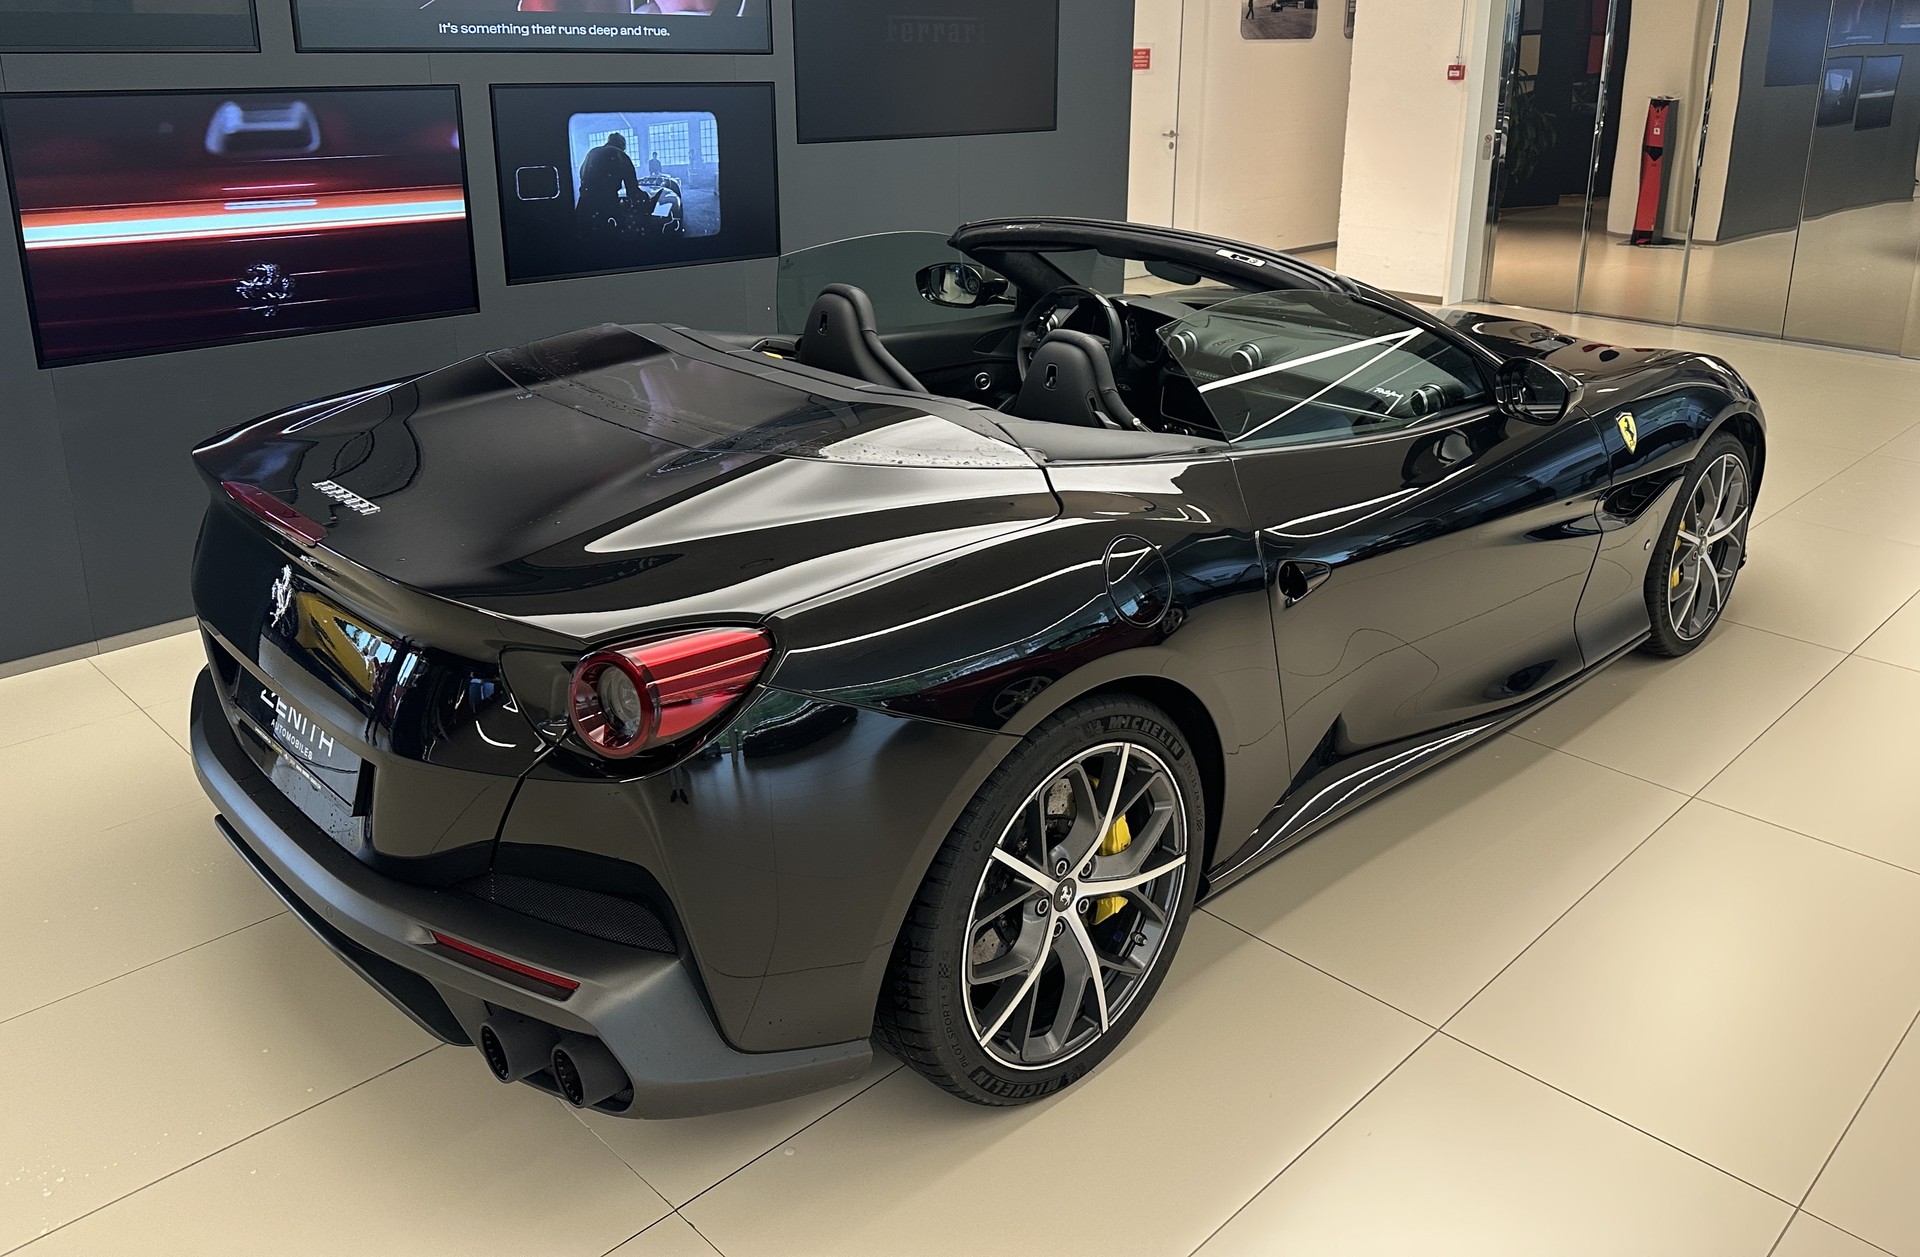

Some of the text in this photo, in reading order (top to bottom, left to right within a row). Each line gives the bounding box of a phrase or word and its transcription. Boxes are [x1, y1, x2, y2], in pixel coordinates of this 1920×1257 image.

[438, 22, 671, 38] It's something that runs deep and true.
[259, 688, 335, 758] ZENITH
[270, 718, 314, 760] AUTOMOBILES
[1107, 715, 1183, 757] MICHELIN
[942, 1002, 956, 1040] SPORT
[951, 1042, 969, 1068] PILOT
[971, 1070, 1062, 1098] MICHELIN
